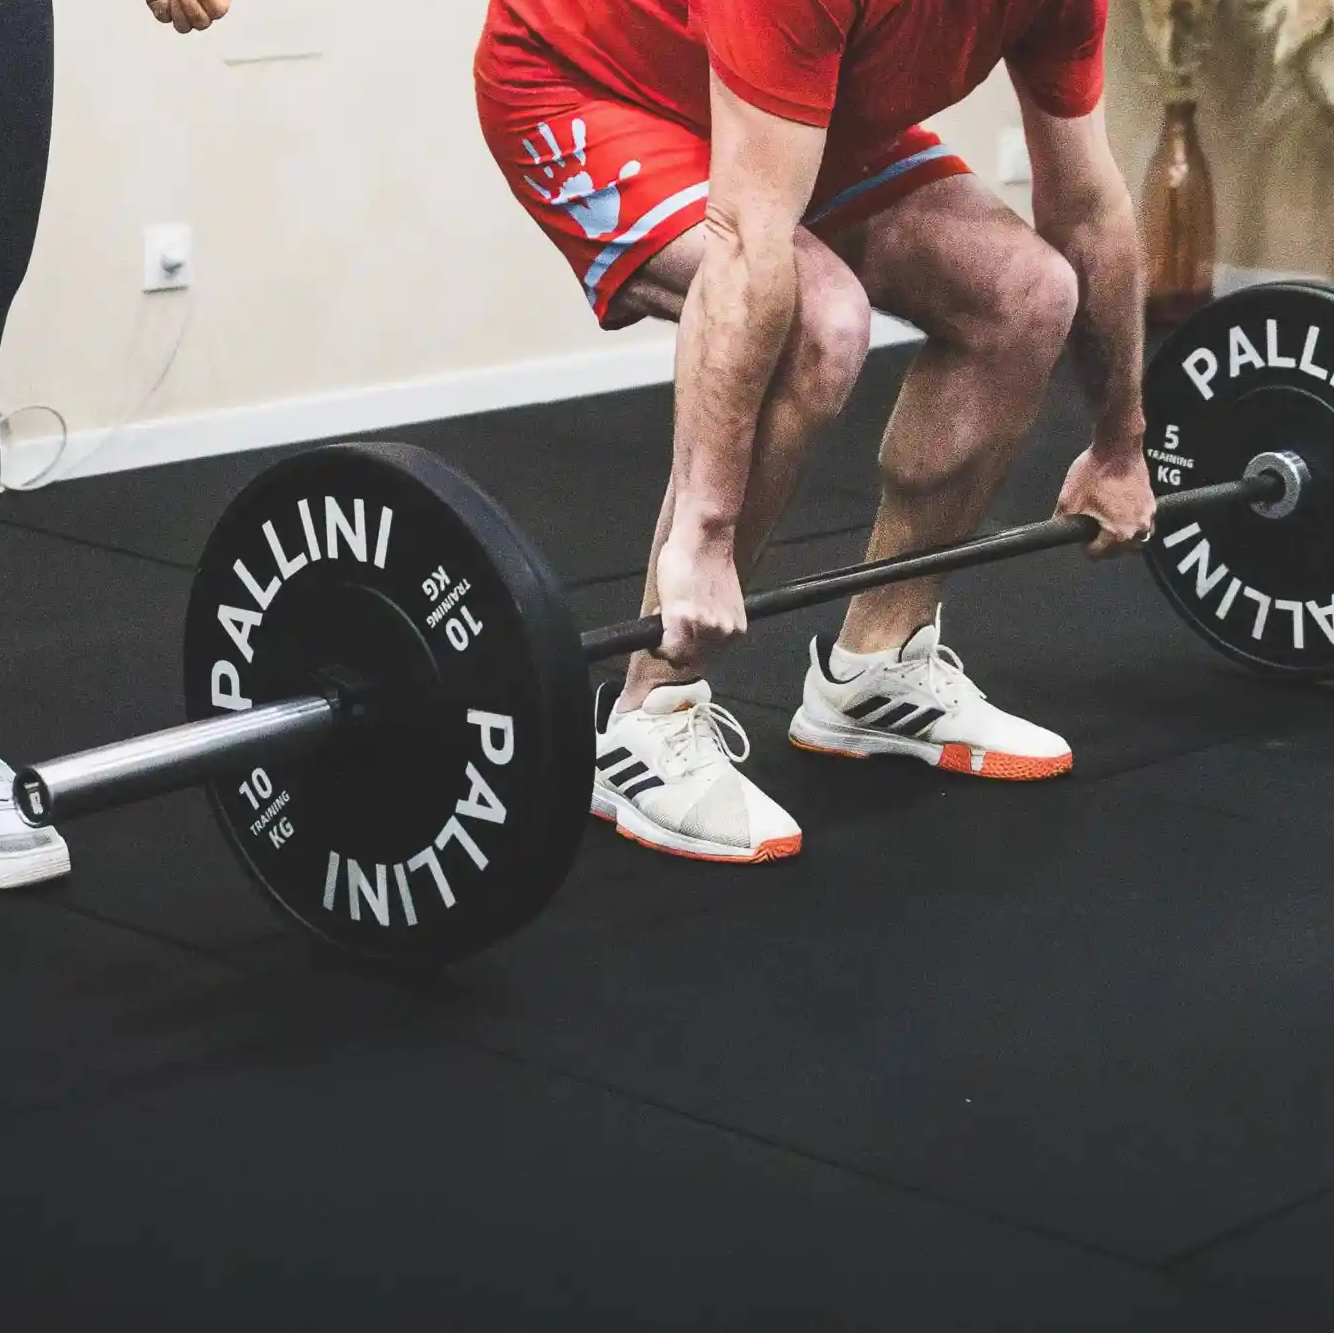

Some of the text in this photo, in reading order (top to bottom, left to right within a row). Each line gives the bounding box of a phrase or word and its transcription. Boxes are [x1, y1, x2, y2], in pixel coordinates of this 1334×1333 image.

[1146, 448, 1195, 469] TRAINING
[1164, 424, 1180, 449] 5
[1157, 465, 1182, 487] KG
[211, 495, 393, 711] PALLINI
[421, 564, 451, 603] KG
[427, 577, 471, 630] TRAINING
[444, 604, 484, 654] 10
[238, 766, 273, 811] 10
[249, 789, 291, 837] TRAINING
[269, 815, 296, 850] KG
[322, 708, 516, 928] PALLINI
